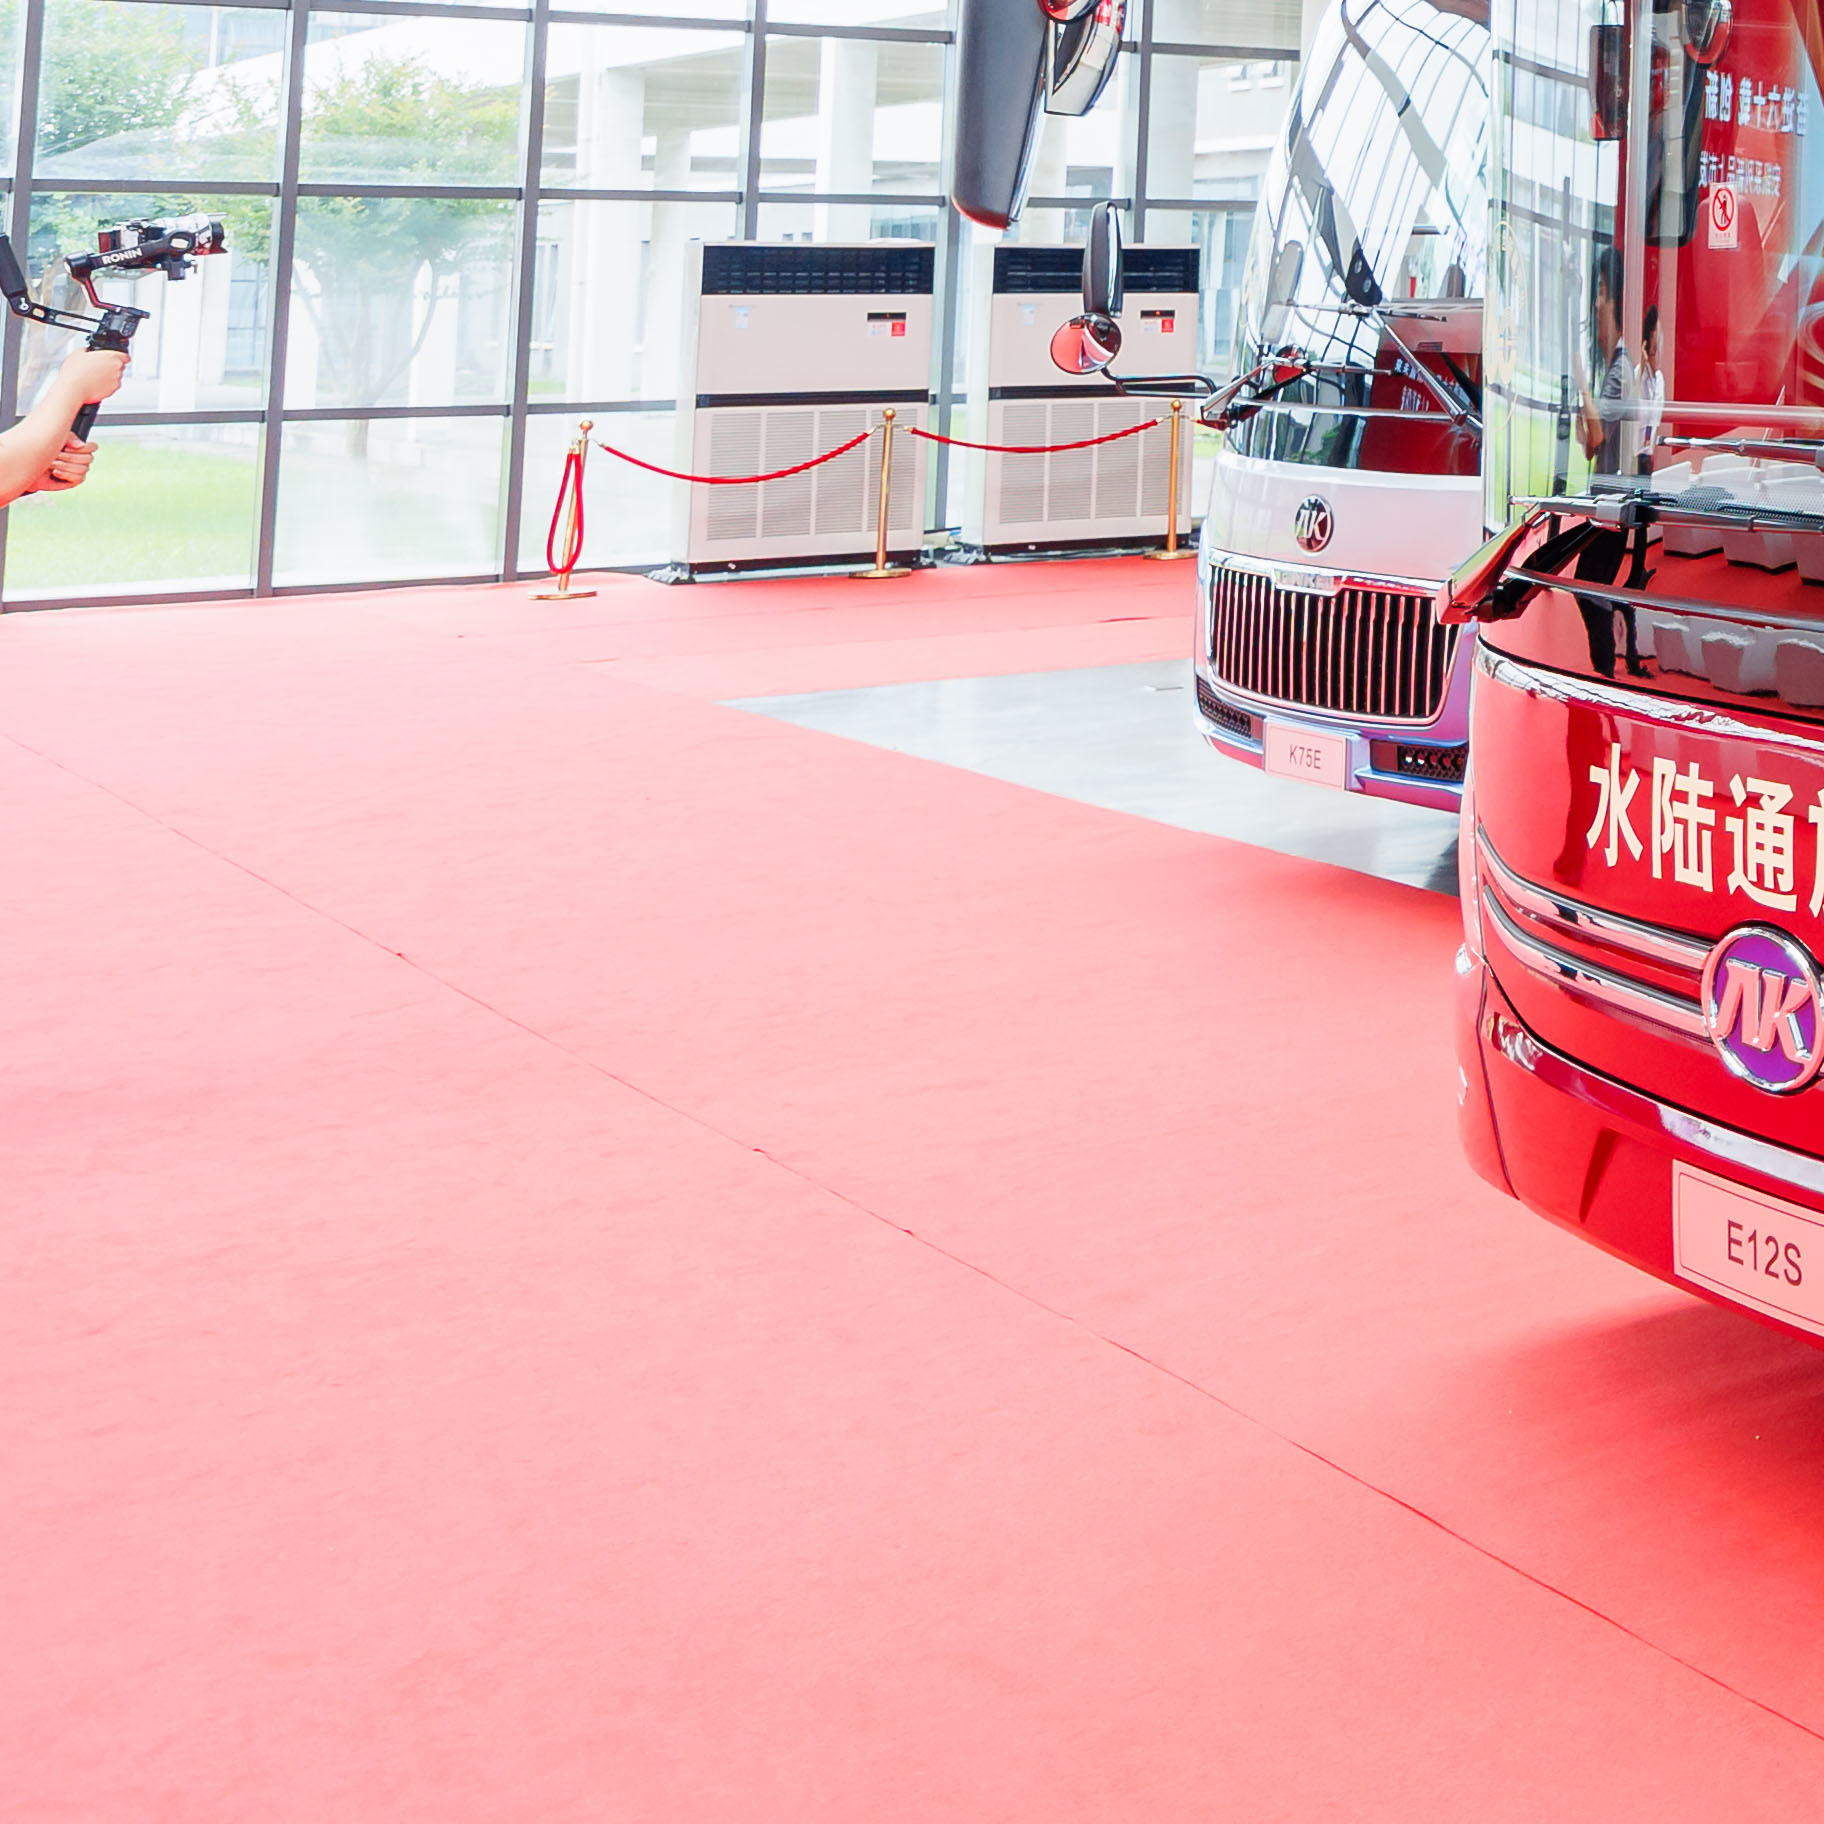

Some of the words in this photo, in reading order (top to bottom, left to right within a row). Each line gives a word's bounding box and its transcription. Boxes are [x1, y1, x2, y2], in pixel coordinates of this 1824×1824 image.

[102, 248, 142, 264] RONIN
[1289, 746, 1321, 770] K75E
[1727, 1218, 1803, 1286] E12S
